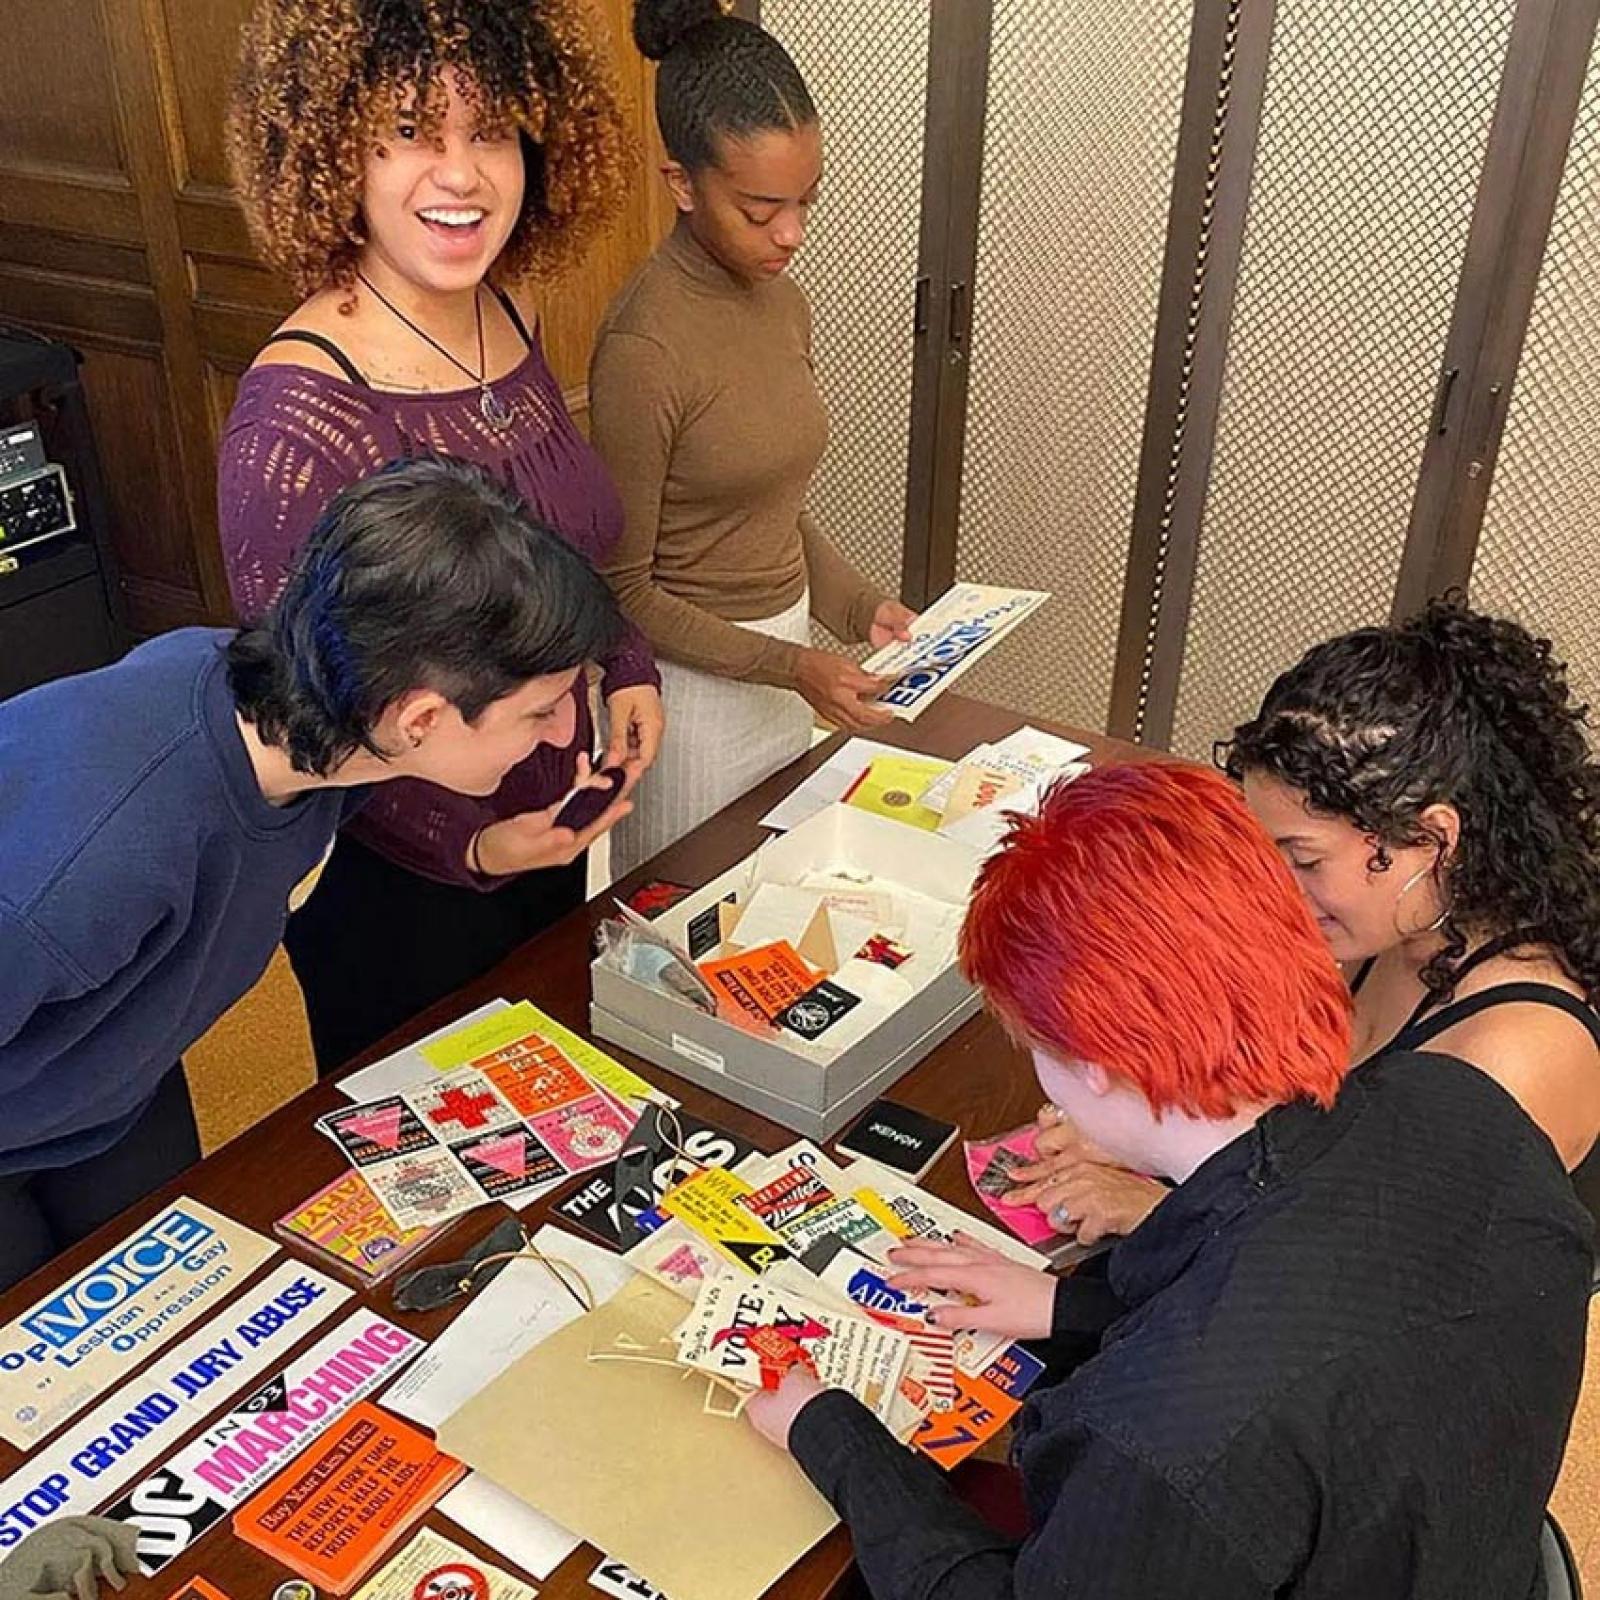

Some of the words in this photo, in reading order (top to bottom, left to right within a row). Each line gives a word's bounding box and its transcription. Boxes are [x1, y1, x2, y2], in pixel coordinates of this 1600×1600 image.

[562, 1178, 613, 1217] THE
[56, 1304, 145, 1369] Lesbian
[183, 1239, 230, 1275] Gay
[111, 1264, 233, 1354] Oppression
[853, 1282, 911, 1315] AIDS
[0, 1472, 72, 1547] STOP
[70, 1391, 182, 1478] GRAND
[171, 1338, 245, 1400] JURY
[236, 1277, 327, 1347] ABUSE
[195, 1321, 412, 1496] MARCHING
[204, 1417, 242, 1450] IN
[260, 1504, 293, 1531] Buy
[287, 1476, 320, 1503] Your
[313, 1452, 345, 1481] Lies
[286, 1520, 310, 1542] THE
[308, 1494, 339, 1521] NEW
[333, 1465, 367, 1494] YORK
[362, 1435, 397, 1466] TIMES
[302, 1503, 355, 1553] REPORTS
[350, 1475, 379, 1504] HALF
[375, 1455, 402, 1478] THE
[320, 1524, 362, 1560] TRUTH
[357, 1486, 395, 1525] ABOUT
